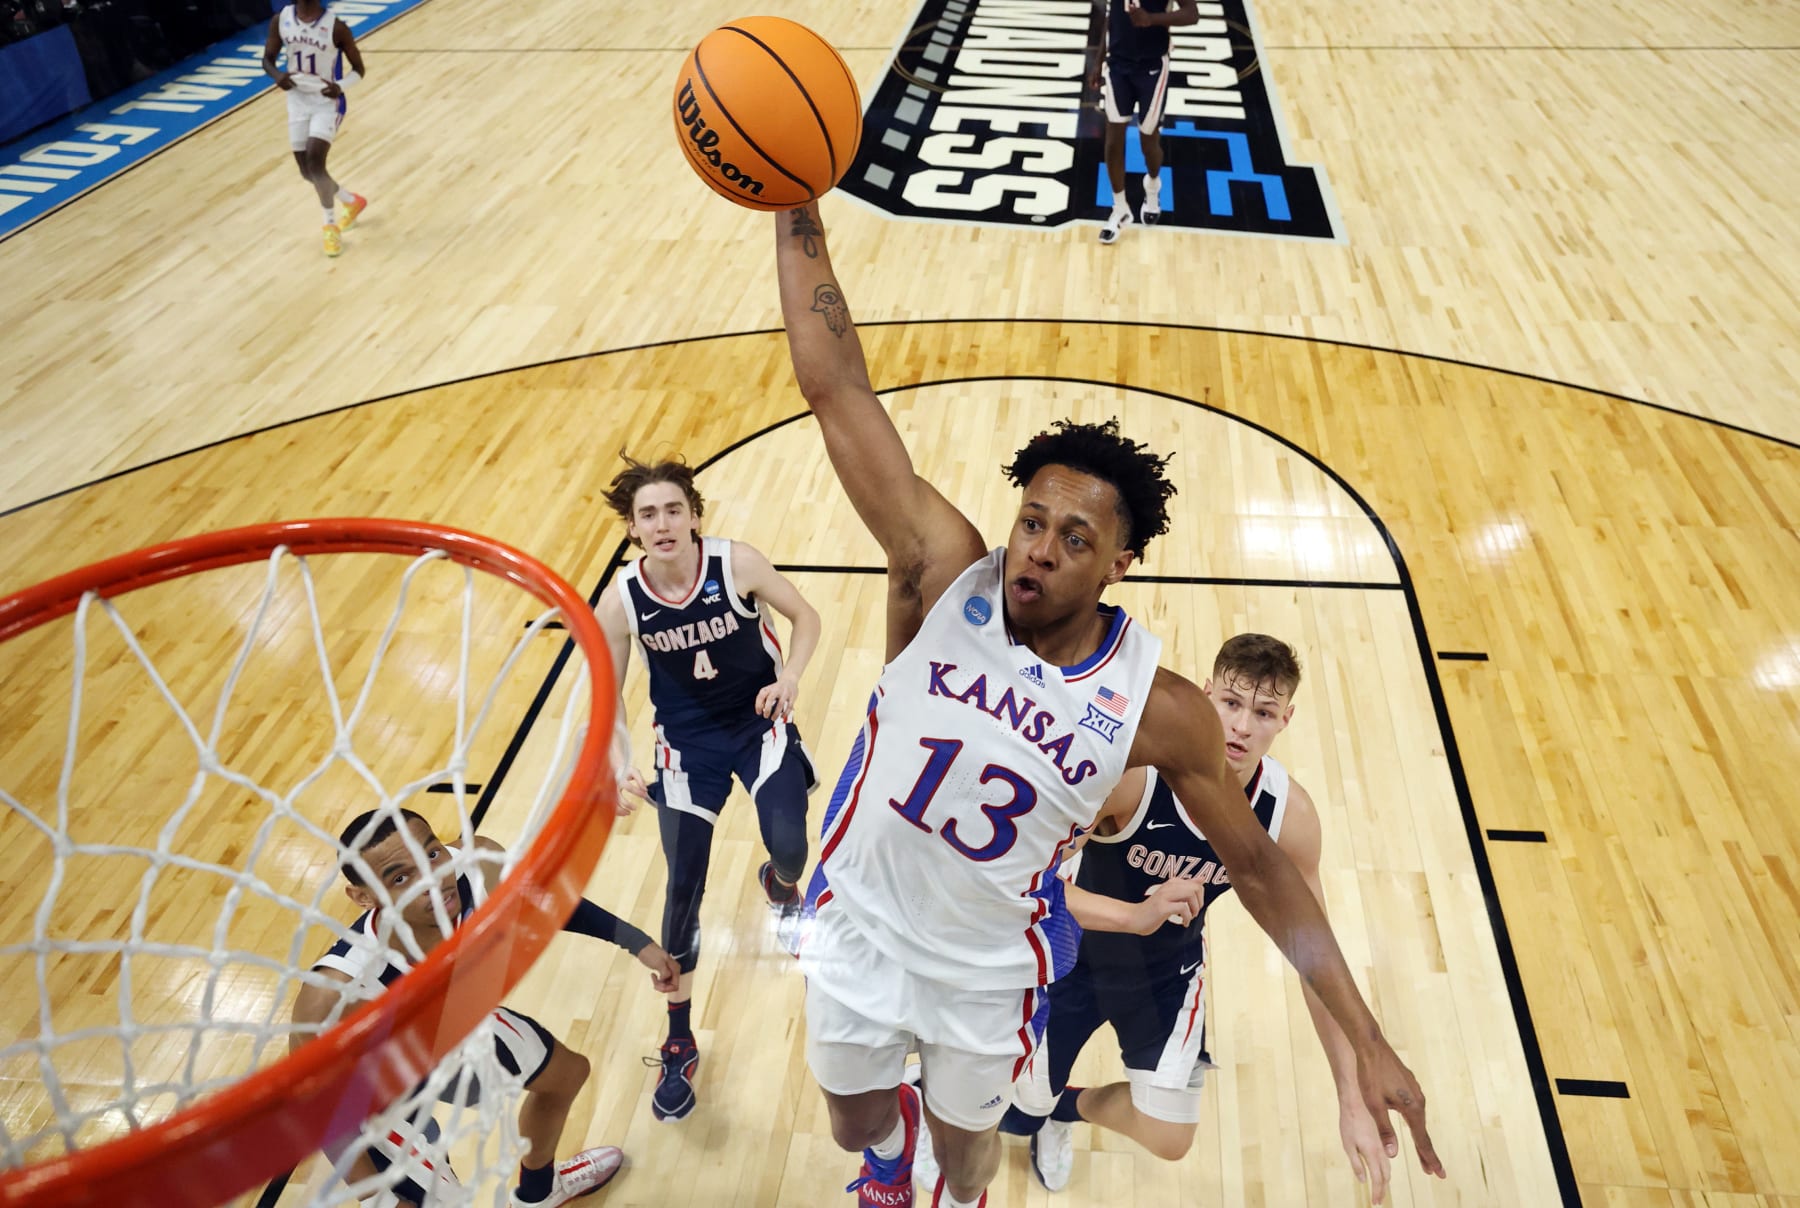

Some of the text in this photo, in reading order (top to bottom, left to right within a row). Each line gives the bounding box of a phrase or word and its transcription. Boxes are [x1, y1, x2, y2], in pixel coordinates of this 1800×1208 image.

[293, 50, 320, 77] 11
[678, 78, 764, 196] Wilson
[902, 0, 1093, 216] MADNESS
[0, 122, 161, 216] FOU
[641, 611, 740, 652] GONZAGA
[693, 650, 719, 681] 4
[1018, 668, 1046, 689] adidas
[928, 661, 1097, 785] KANSAS
[888, 737, 1038, 862] 13
[1127, 844, 1232, 885] GONZAG
